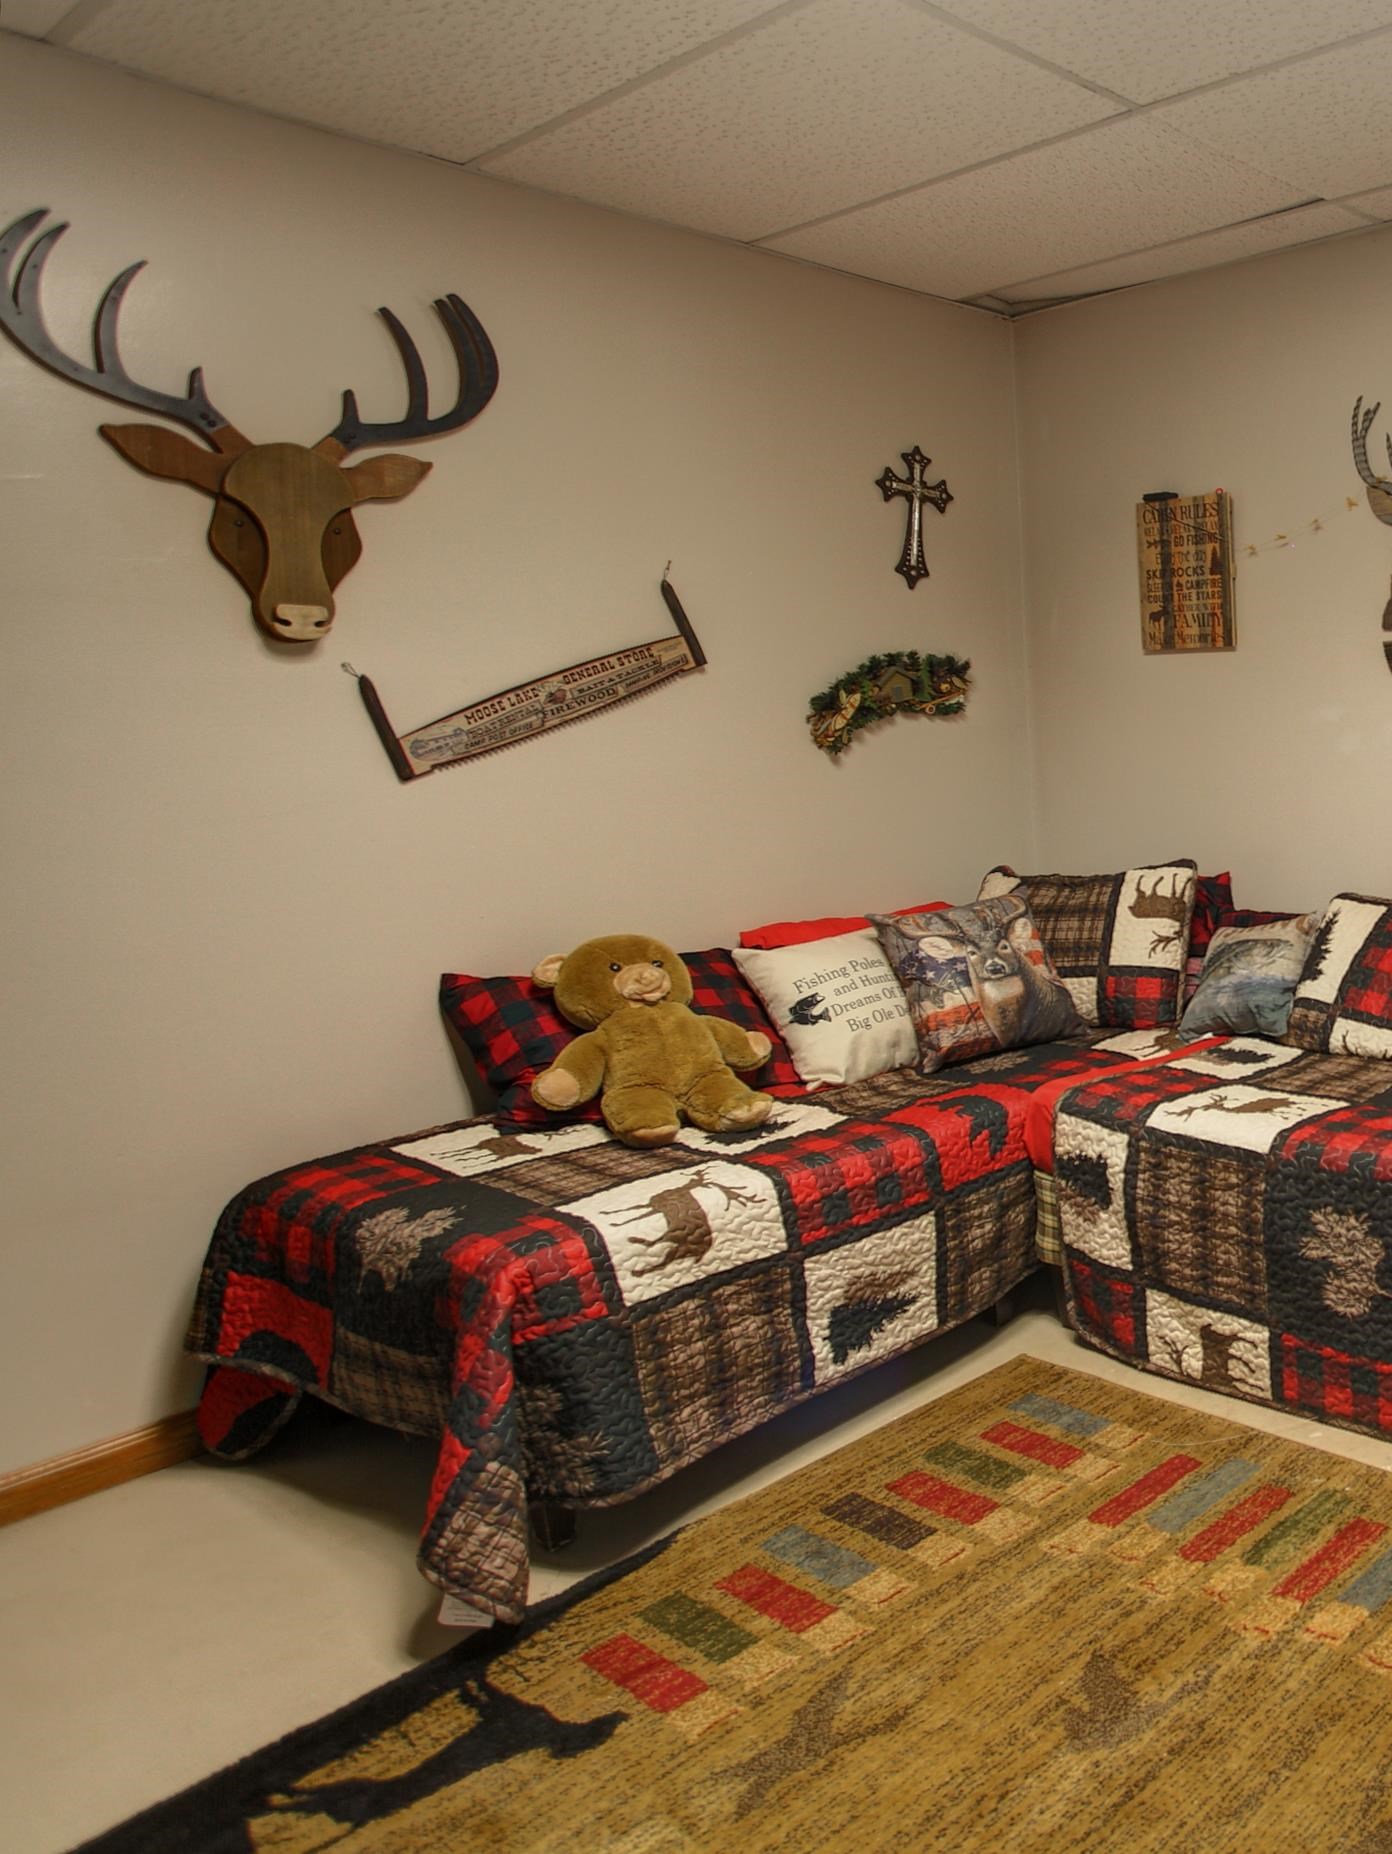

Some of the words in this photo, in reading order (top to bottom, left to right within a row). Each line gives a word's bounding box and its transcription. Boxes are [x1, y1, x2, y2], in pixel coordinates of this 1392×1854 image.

[1180, 502, 1218, 520] RULES
[464, 700, 506, 725] MOOSE
[507, 687, 540, 707] LAKE
[562, 660, 616, 685] GENERAL
[616, 647, 655, 666] STORE
[543, 687, 617, 718] FIREWOOD
[793, 964, 851, 995] Fishing
[848, 957, 885, 973] Poles
[833, 980, 859, 997] and
[830, 991, 882, 1017] Dreams
[846, 1016, 873, 1033] Big
[872, 1007, 895, 1024] Ole
